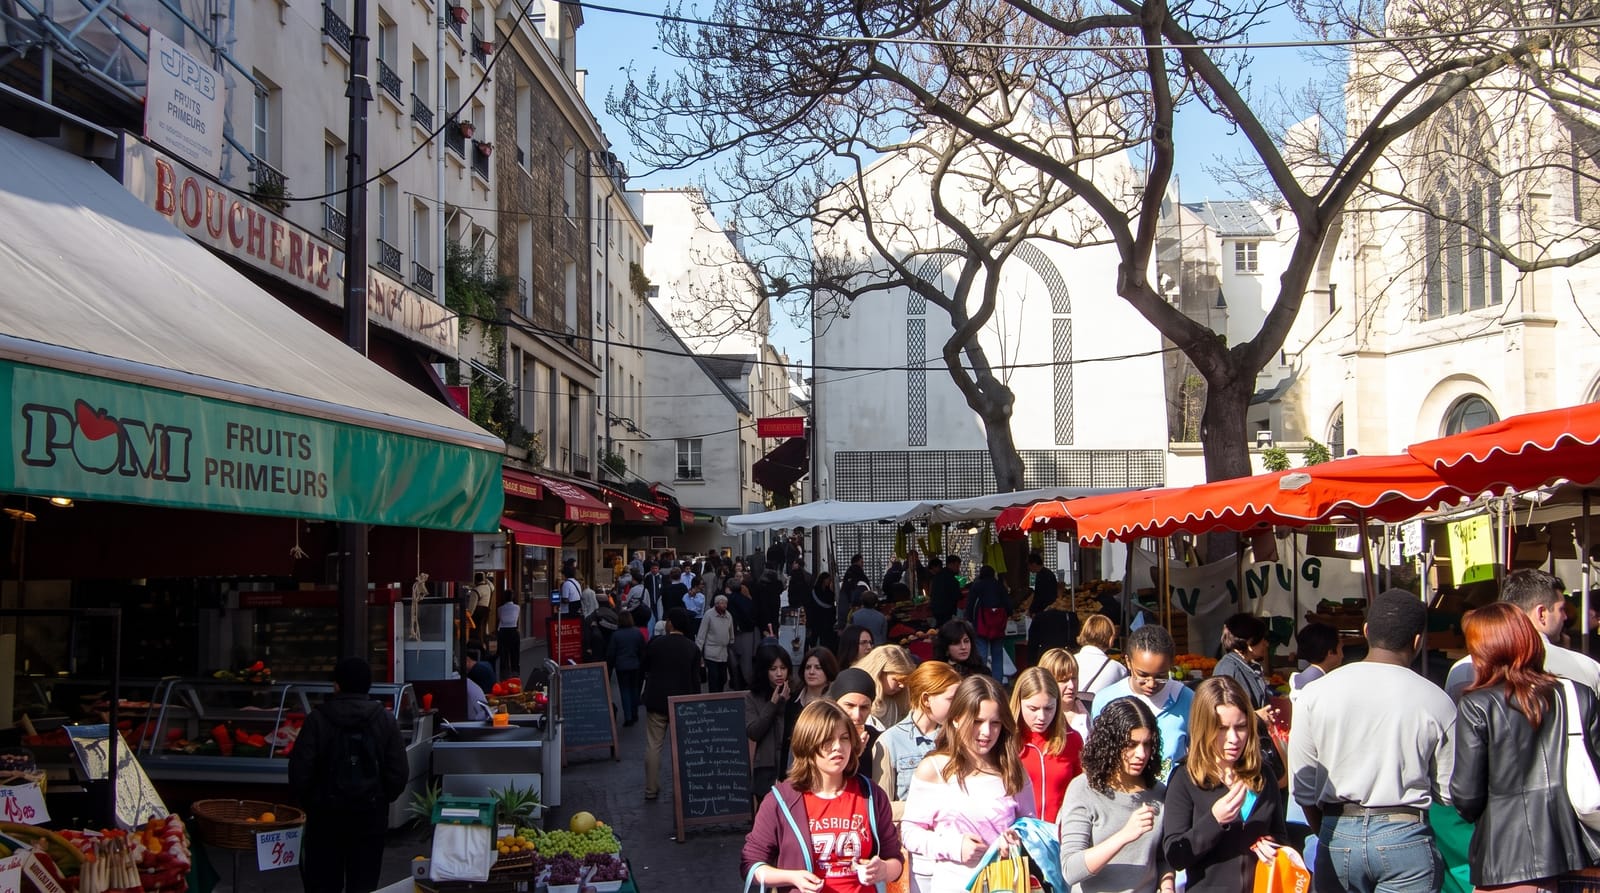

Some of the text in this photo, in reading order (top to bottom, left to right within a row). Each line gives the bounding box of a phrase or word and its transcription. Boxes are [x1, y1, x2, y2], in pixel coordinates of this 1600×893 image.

[160, 47, 216, 101] JPB
[167, 101, 206, 135] PRIMEURS
[174, 88, 201, 115] FRUITS
[155, 157, 332, 291] BOUCHERIE
[226, 422, 312, 461] FRUITS
[204, 457, 328, 499] PRIMEURS
